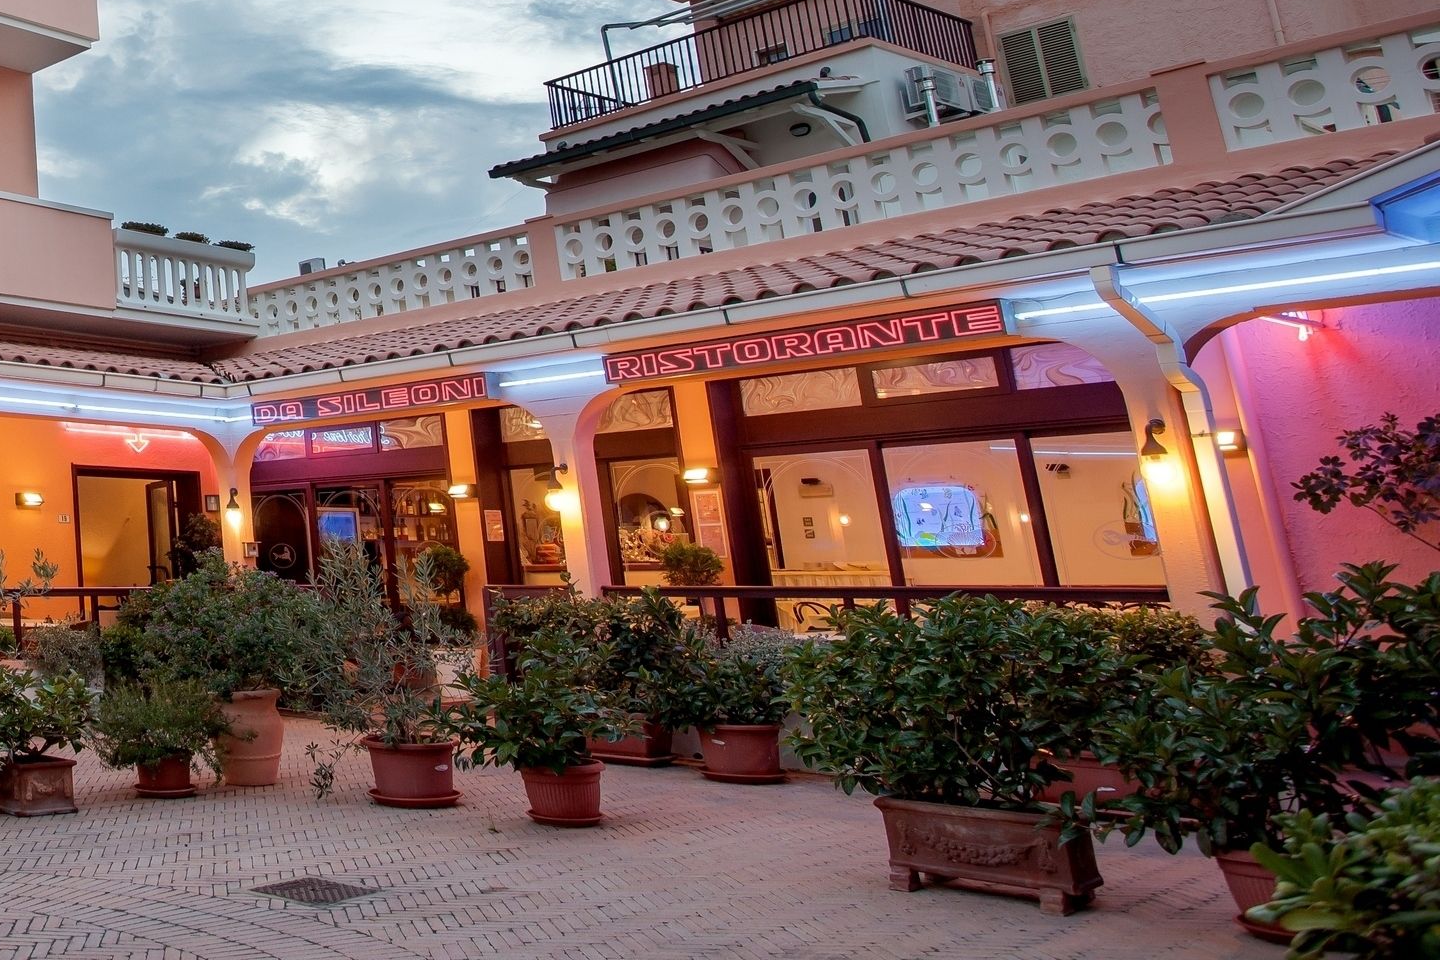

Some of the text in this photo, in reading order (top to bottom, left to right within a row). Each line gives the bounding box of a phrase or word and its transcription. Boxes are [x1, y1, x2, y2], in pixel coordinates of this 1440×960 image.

[605, 304, 1003, 382] RISTORANTE
[253, 376, 486, 423] DA SILEONI
